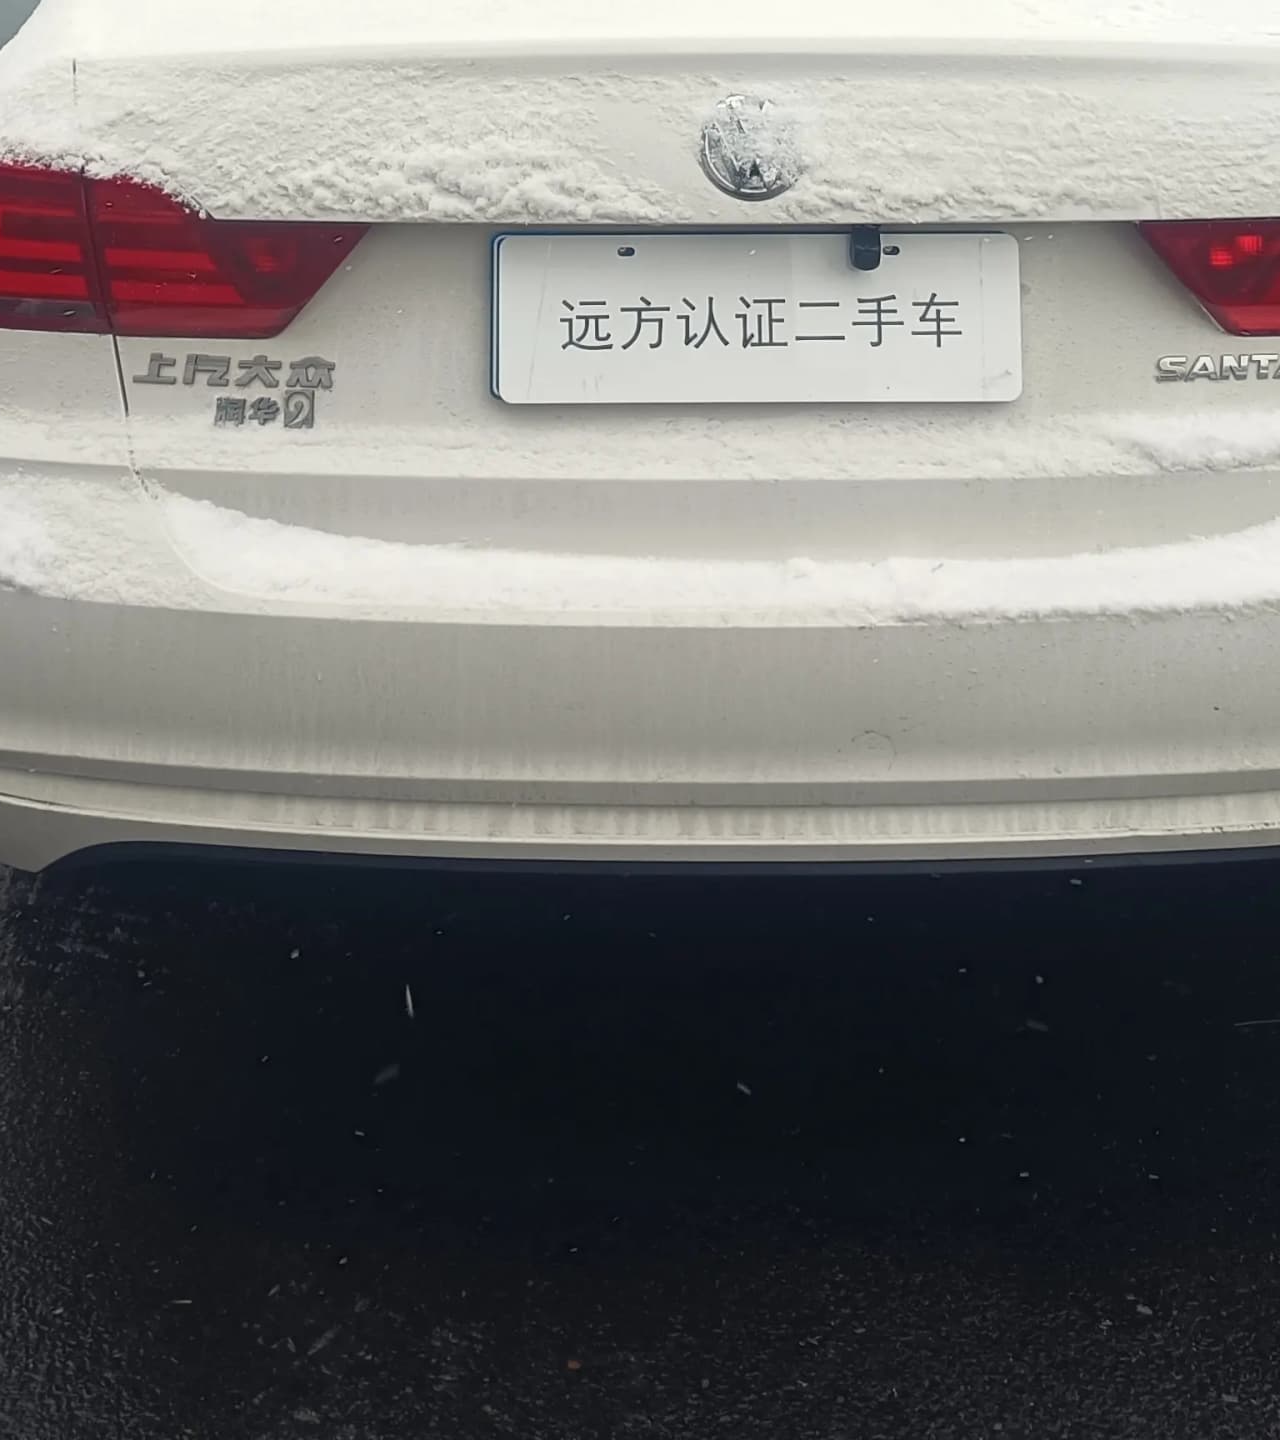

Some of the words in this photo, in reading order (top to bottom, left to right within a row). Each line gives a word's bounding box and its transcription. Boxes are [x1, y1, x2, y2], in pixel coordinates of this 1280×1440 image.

[559, 293, 963, 351] 远方认证二手车
[132, 352, 336, 389] 上汽大众
